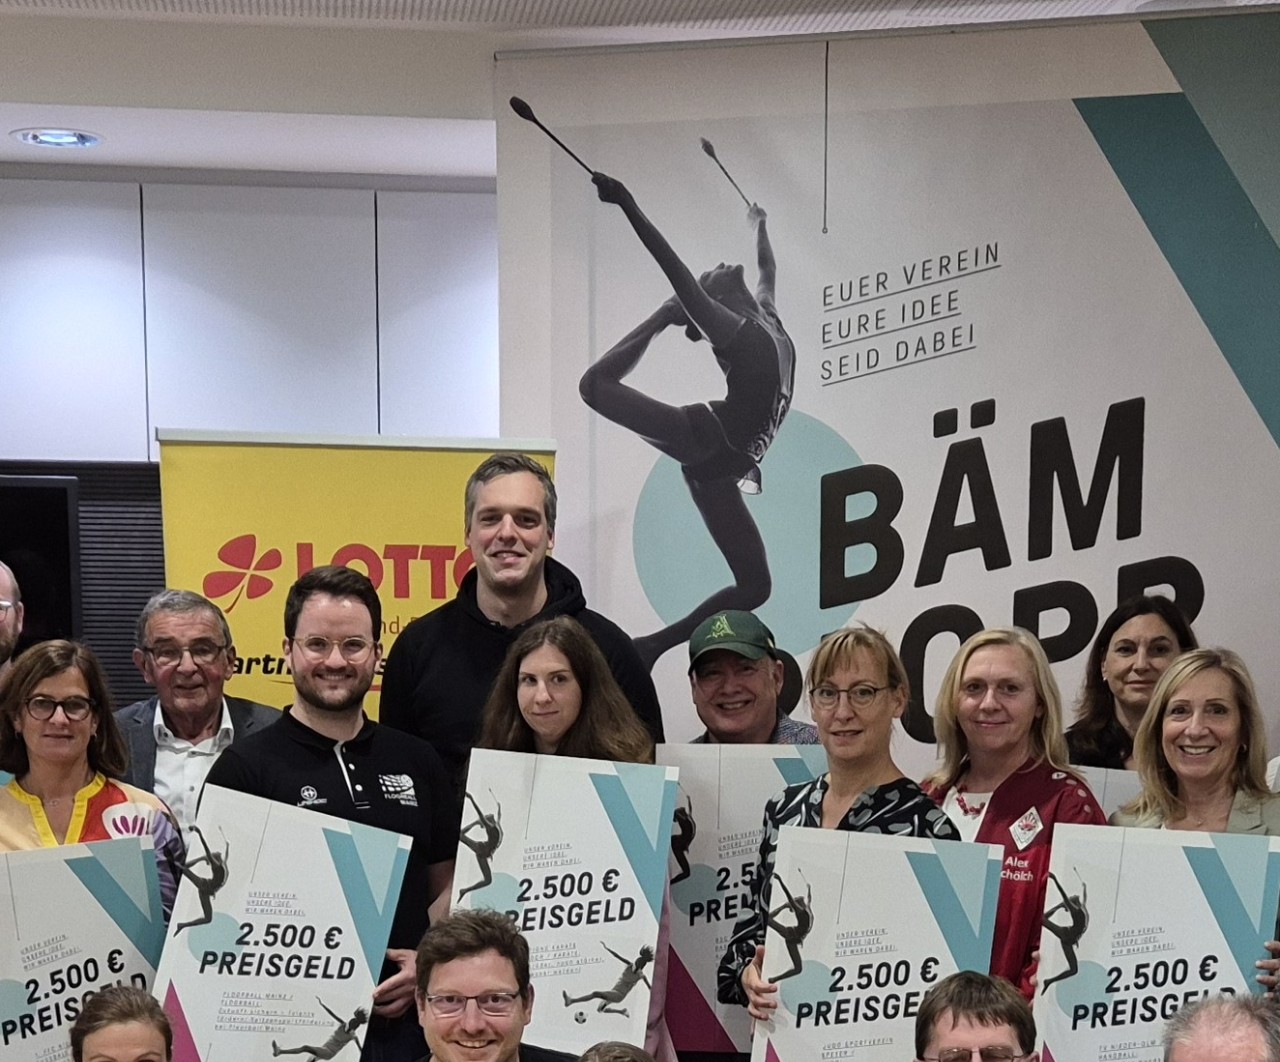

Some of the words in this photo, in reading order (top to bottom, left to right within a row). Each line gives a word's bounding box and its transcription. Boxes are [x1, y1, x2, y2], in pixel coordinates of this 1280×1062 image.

[823, 271, 888, 307] EUER
[902, 241, 999, 286] VEREIN
[822, 308, 886, 345] EURE
[901, 289, 960, 325] IDEE
[821, 347, 880, 381] SEID
[896, 323, 975, 363] DABEI
[819, 396, 1146, 610] BÄM
[776, 555, 1205, 744] OPP
[516, 871, 593, 903] 2.500
[602, 868, 620, 893] €
[717, 862, 757, 892] 2.5
[1001, 868, 1035, 881] chölch
[505, 896, 635, 932] REISGELD
[235, 922, 316, 948] 2.500
[324, 926, 343, 950] €
[25, 958, 100, 1005] 2.500
[107, 949, 125, 974] €
[199, 950, 355, 980] PREISGELD
[828, 959, 911, 993] 2.500
[920, 956, 940, 983] €
[1105, 958, 1189, 994] 2.500
[1198, 954, 1219, 982] €
[1, 972, 147, 1045] PREIS
[796, 990, 934, 1029] PREISGE
[1071, 987, 1236, 1031] PREISG
